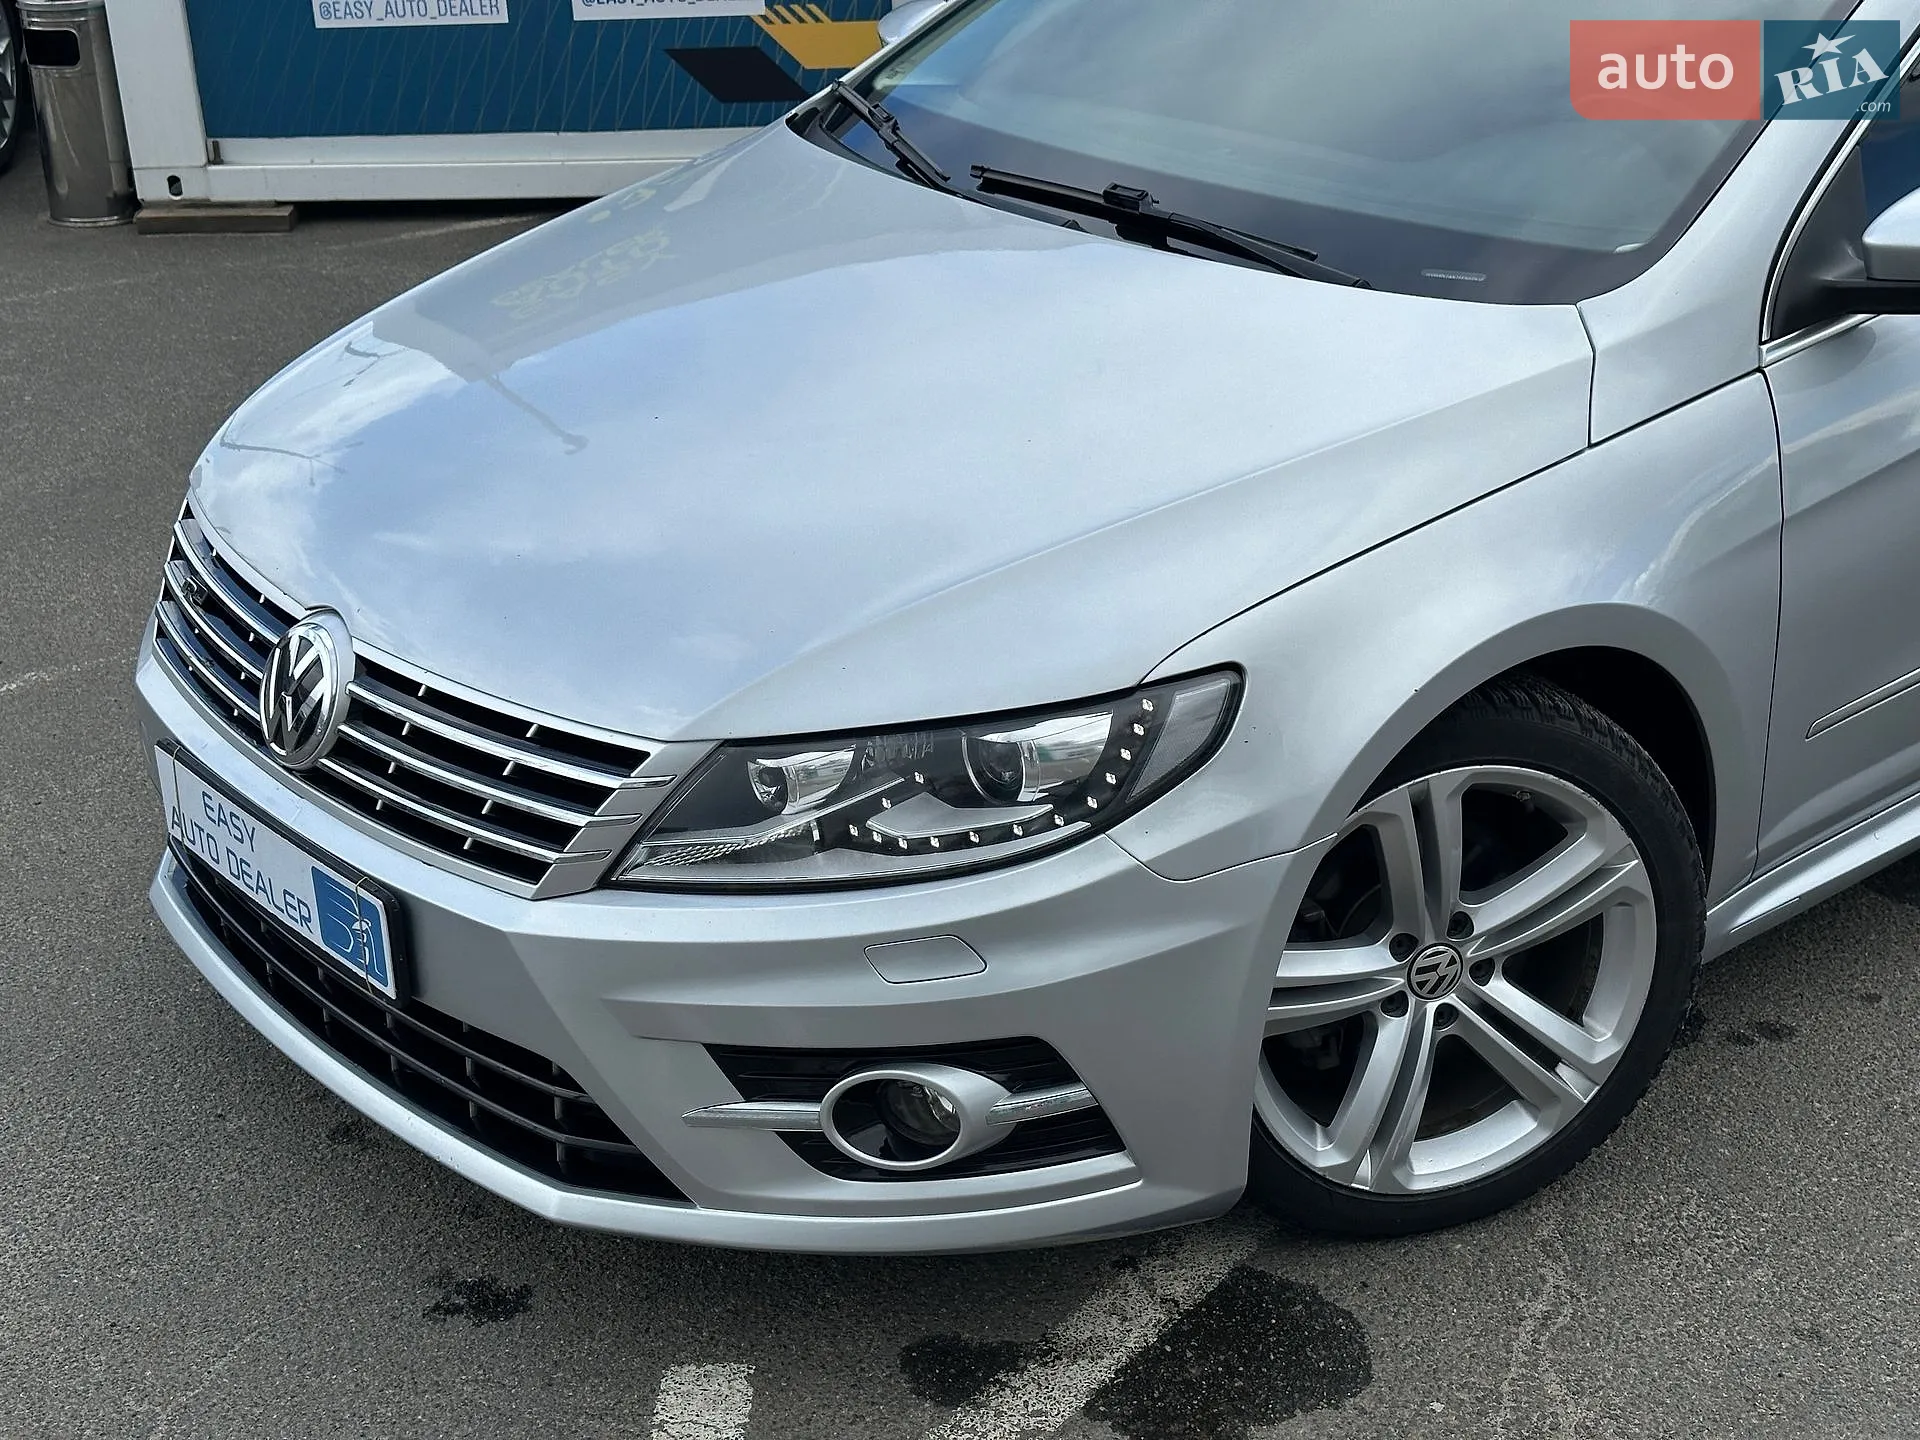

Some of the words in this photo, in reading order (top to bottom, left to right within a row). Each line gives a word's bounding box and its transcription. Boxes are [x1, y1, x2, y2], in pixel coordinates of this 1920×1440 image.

[319, 0, 500, 21] @EASY_AUTO_DEALER
[201, 790, 257, 853] EASY
[170, 805, 221, 865] AUTO
[225, 845, 314, 935] DEALER
